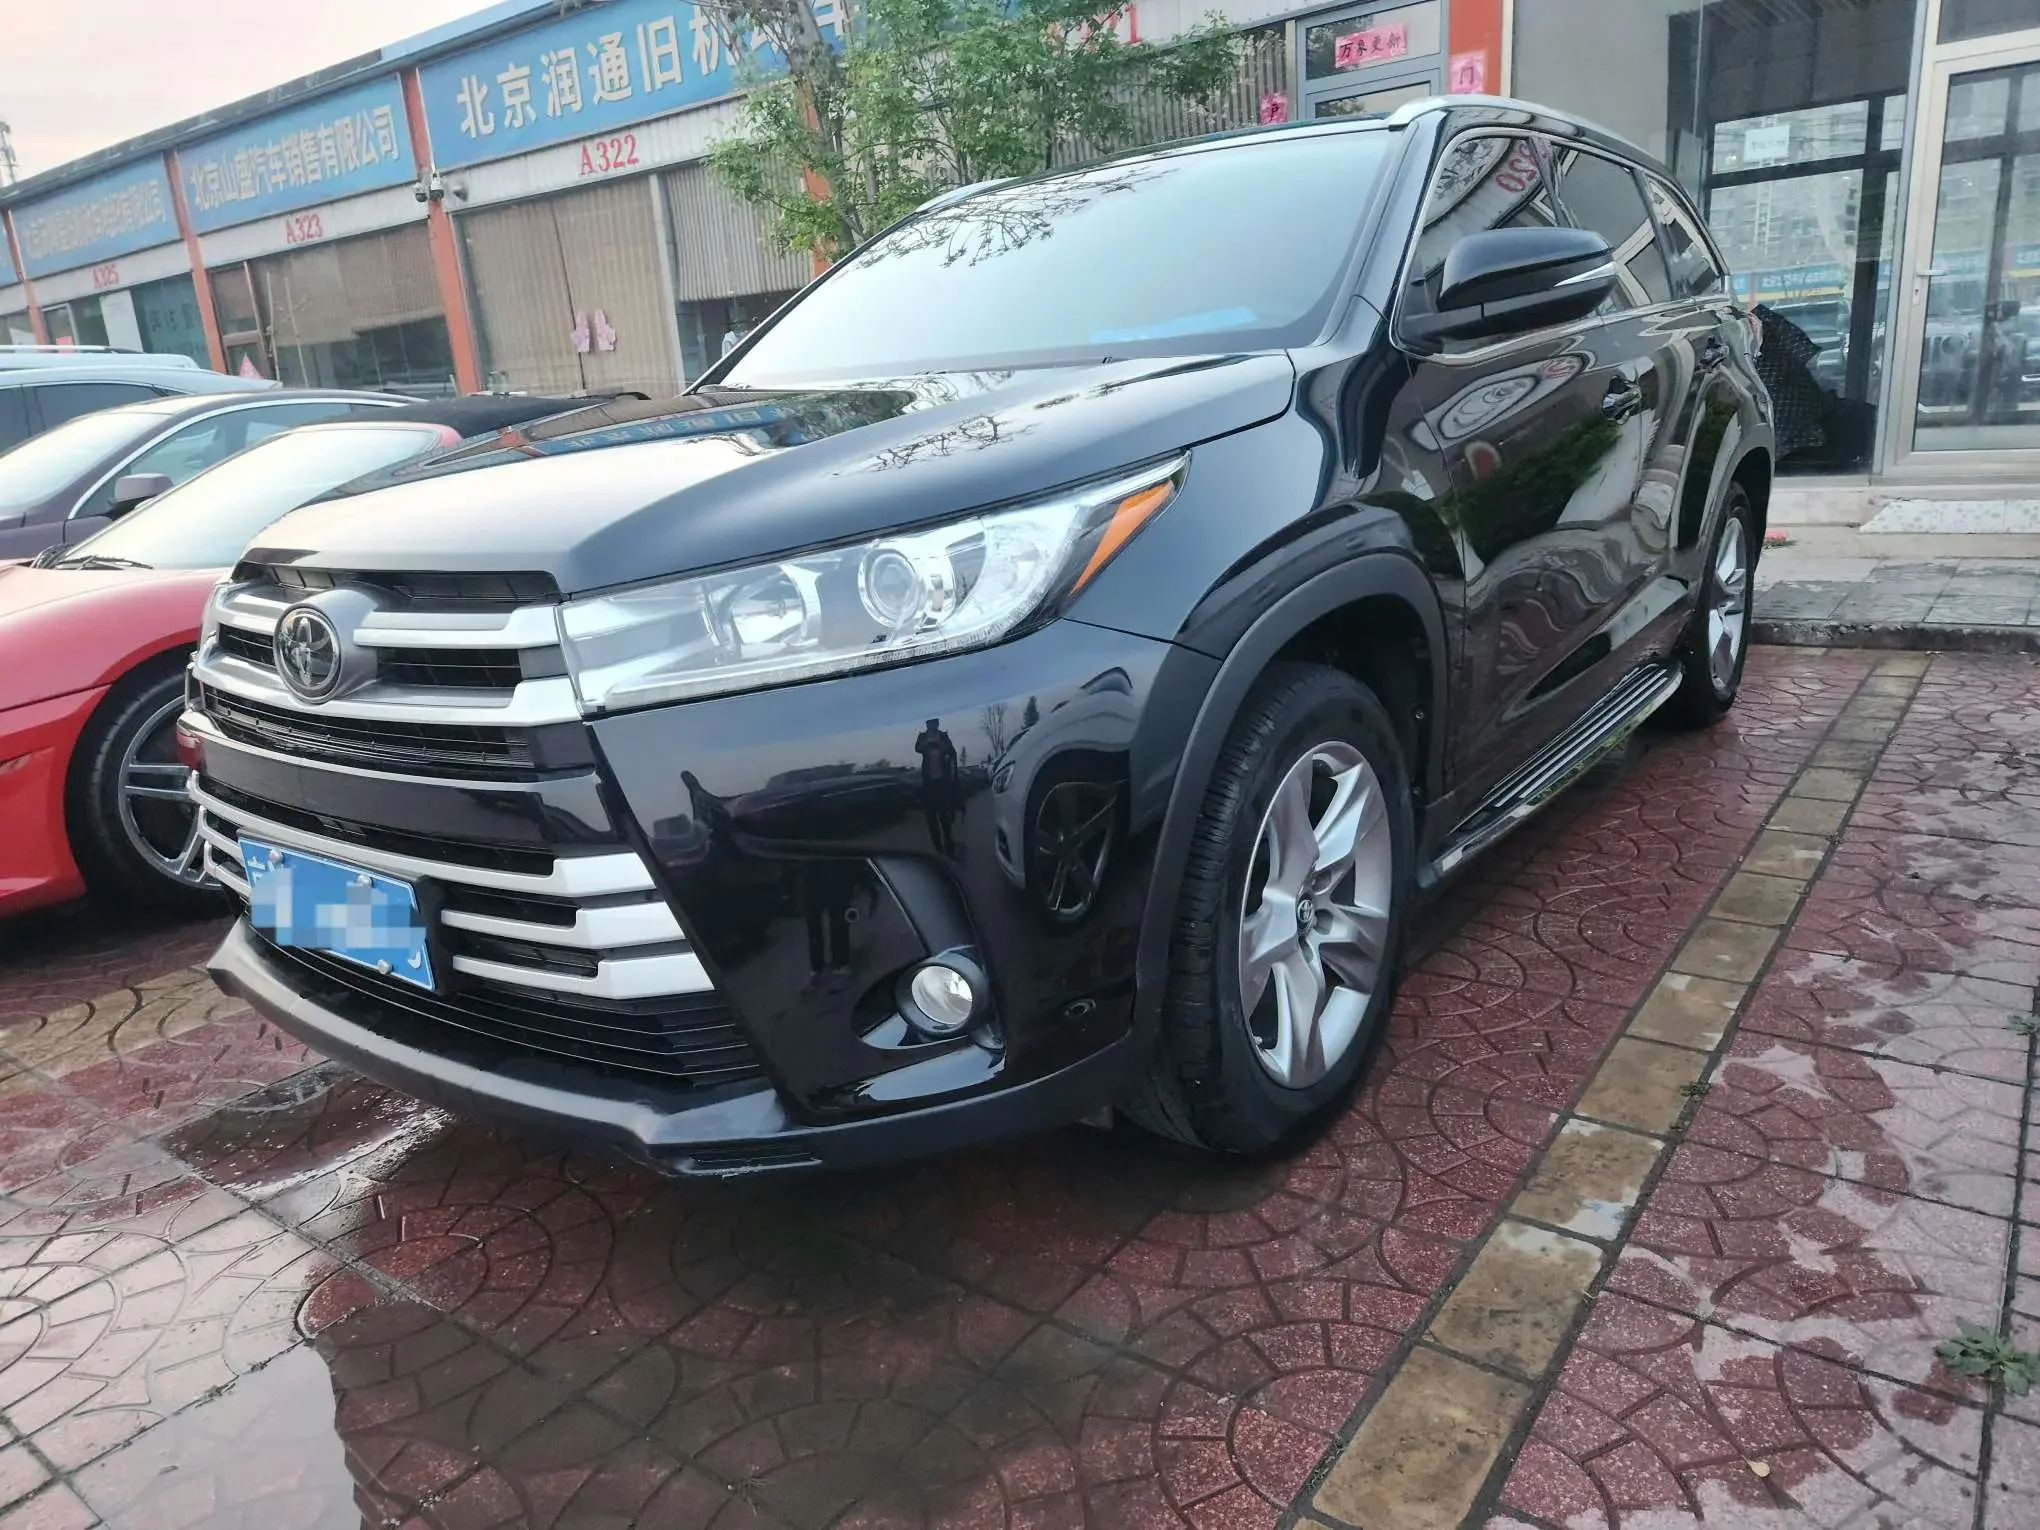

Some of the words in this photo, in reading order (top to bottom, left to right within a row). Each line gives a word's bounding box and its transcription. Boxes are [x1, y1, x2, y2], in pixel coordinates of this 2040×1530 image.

[1339, 32, 1402, 58] 万象更新
[456, 1, 846, 139] 北京润通旧机
[579, 134, 641, 178] A322
[286, 213, 324, 245] A323
